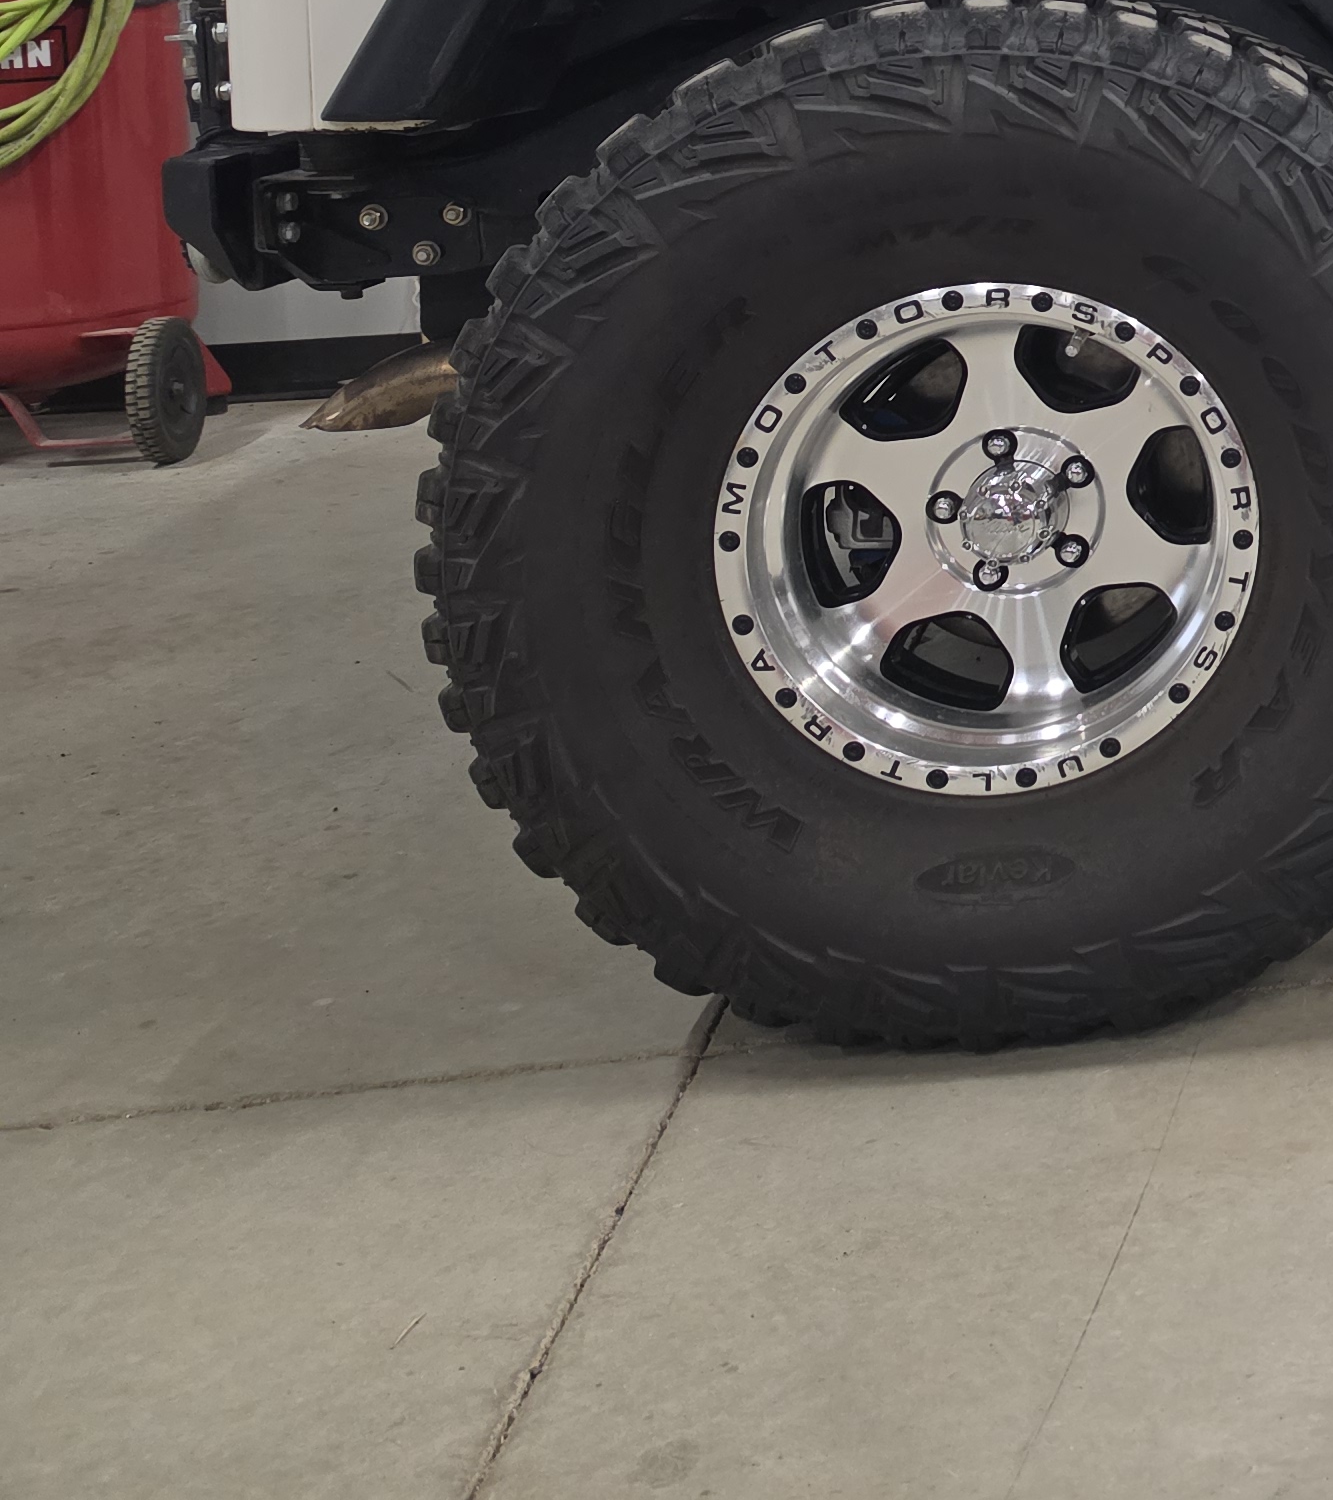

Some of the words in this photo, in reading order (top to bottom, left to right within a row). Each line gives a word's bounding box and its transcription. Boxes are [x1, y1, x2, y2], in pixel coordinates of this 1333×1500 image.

[606, 293, 805, 854] WRANGLER
[722, 286, 1252, 672] MOTORSPORTS
[750, 646, 1086, 793] ULTRA
[941, 853, 1054, 889] Kevlar
